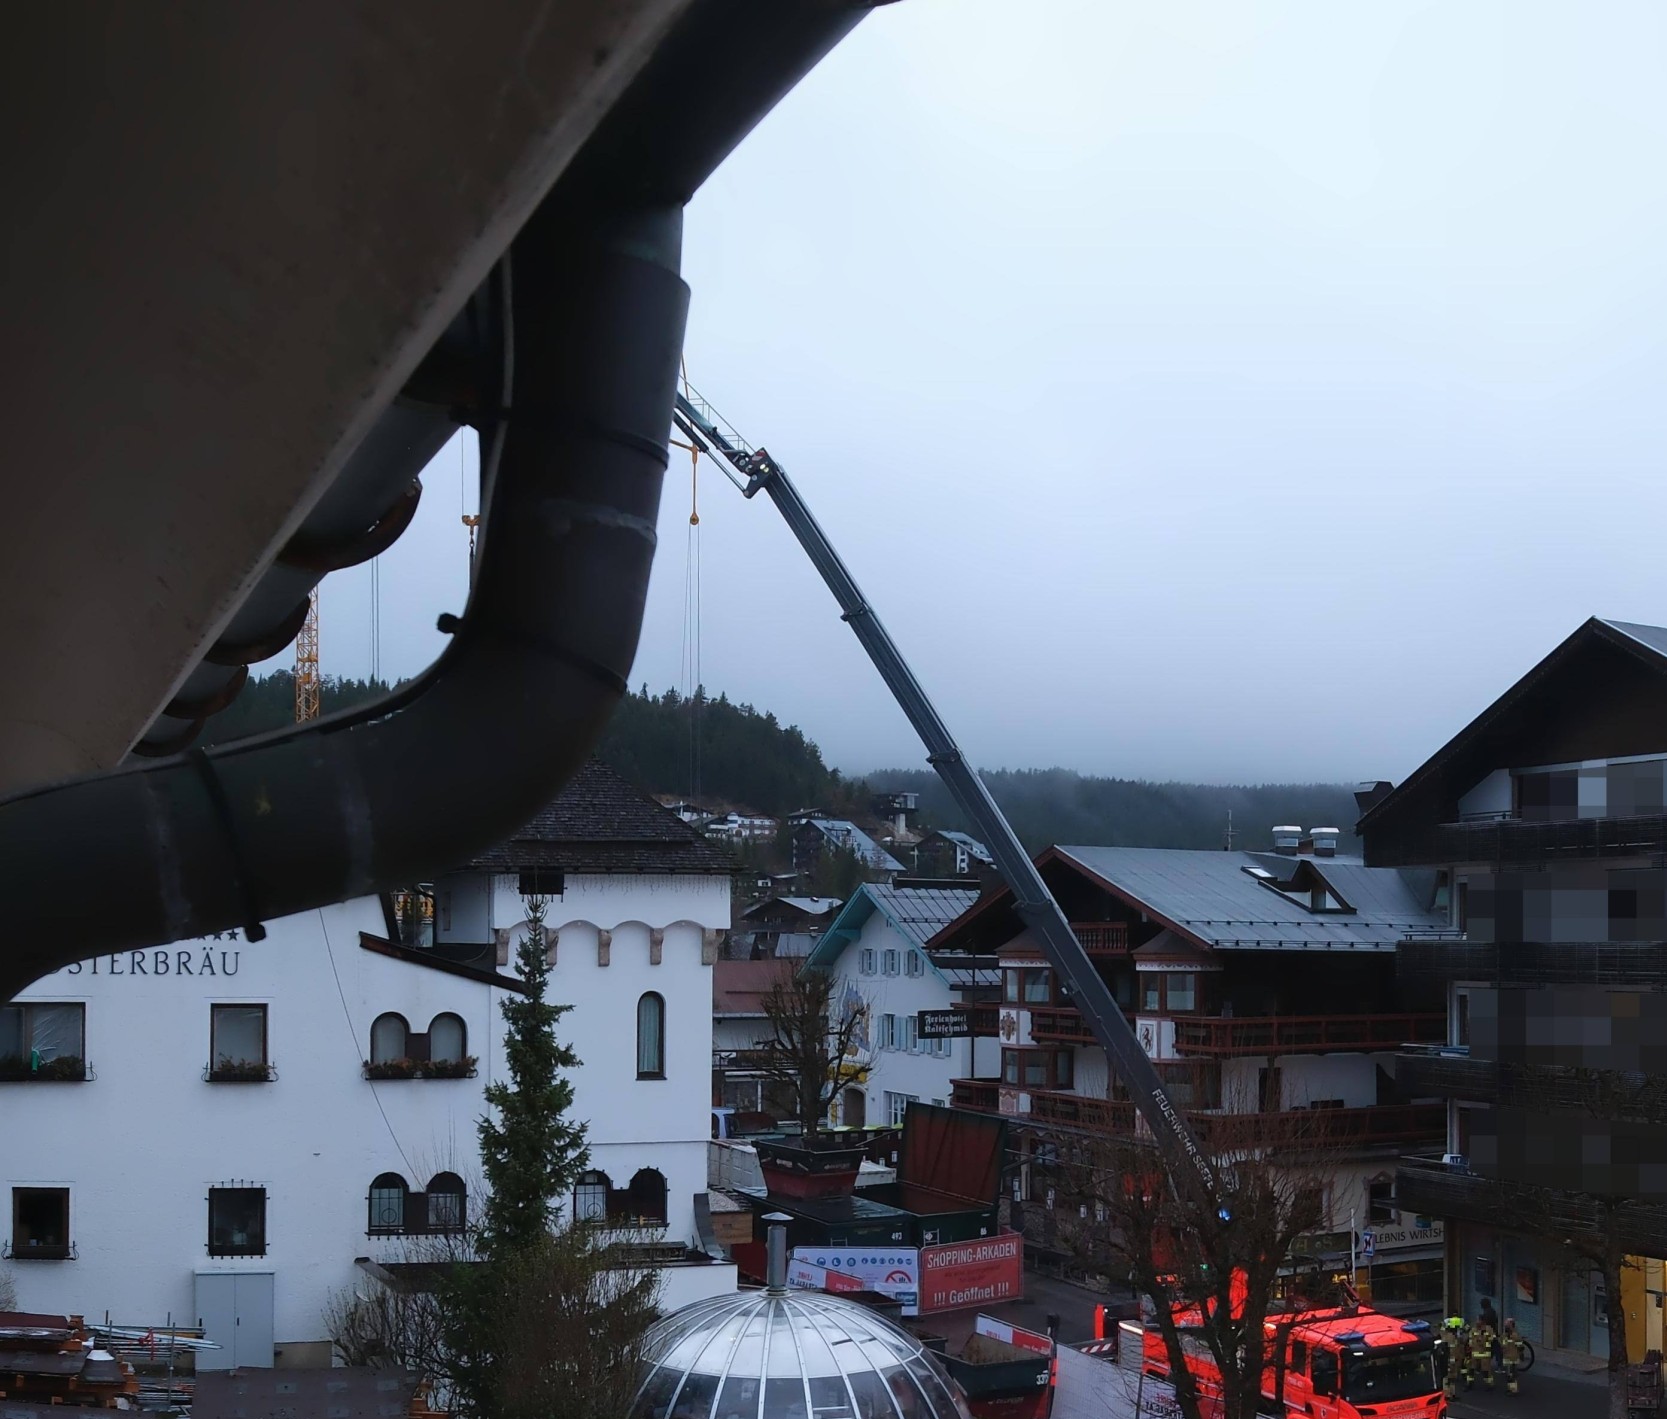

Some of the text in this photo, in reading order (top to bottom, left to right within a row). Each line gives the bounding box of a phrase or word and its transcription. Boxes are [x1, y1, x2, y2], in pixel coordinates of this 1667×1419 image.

[1152, 1088, 1197, 1156] FEUERWEHR
[927, 1241, 1017, 1269] SHOPPING-ARKADEN
[949, 1287, 995, 1304] Geöffnet
